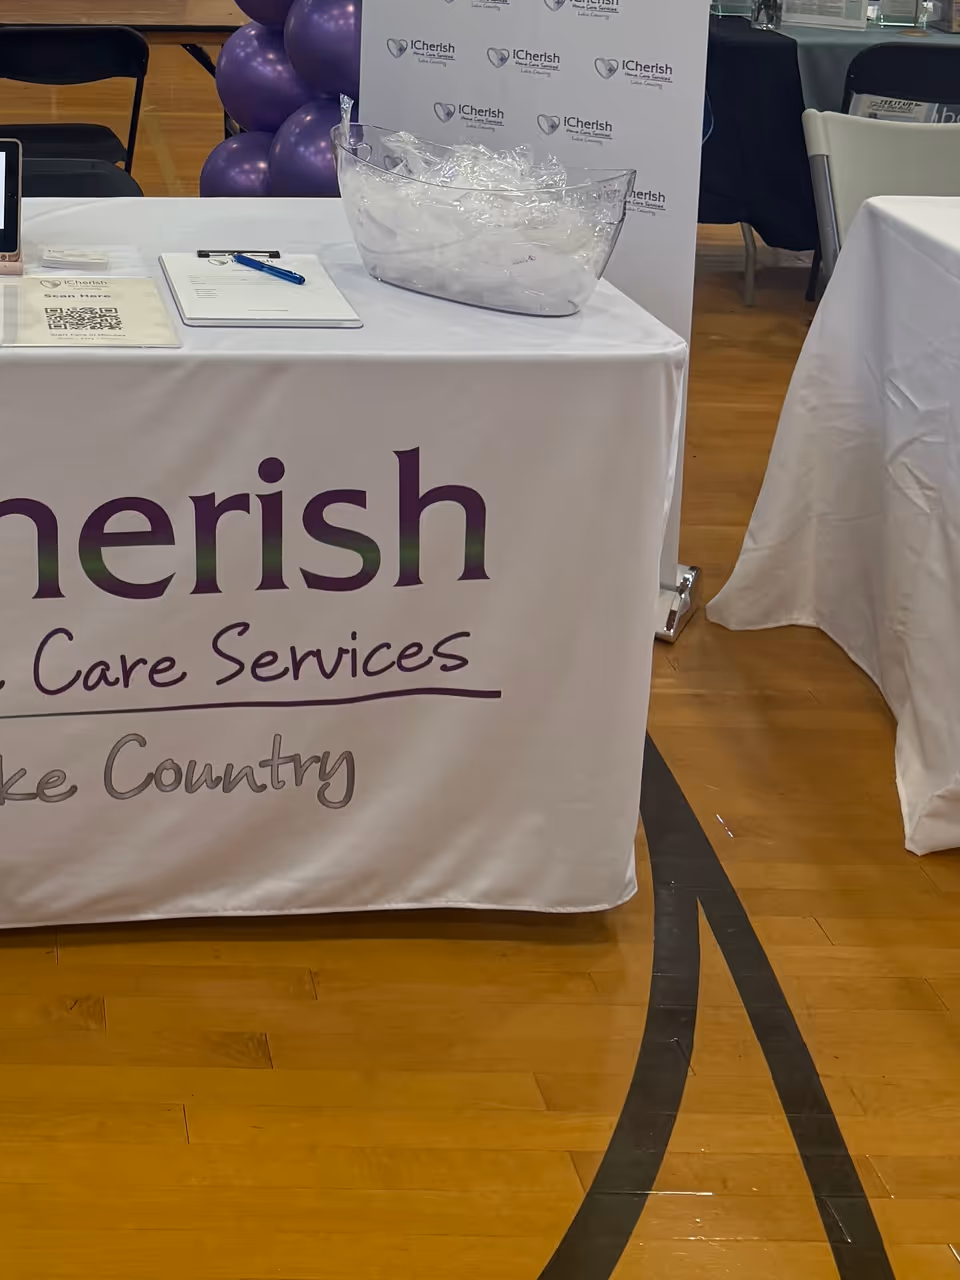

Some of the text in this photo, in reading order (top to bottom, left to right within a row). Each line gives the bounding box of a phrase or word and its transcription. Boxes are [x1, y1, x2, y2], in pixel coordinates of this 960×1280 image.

[411, 40, 455, 53] iCherish
[513, 49, 560, 63] iCherish
[622, 60, 672, 74] iCherish
[458, 104, 504, 119] iCherish
[564, 116, 612, 131] iCherish
[32, 626, 188, 697] Care
[211, 622, 471, 686] Services
[103, 733, 356, 810] Country
